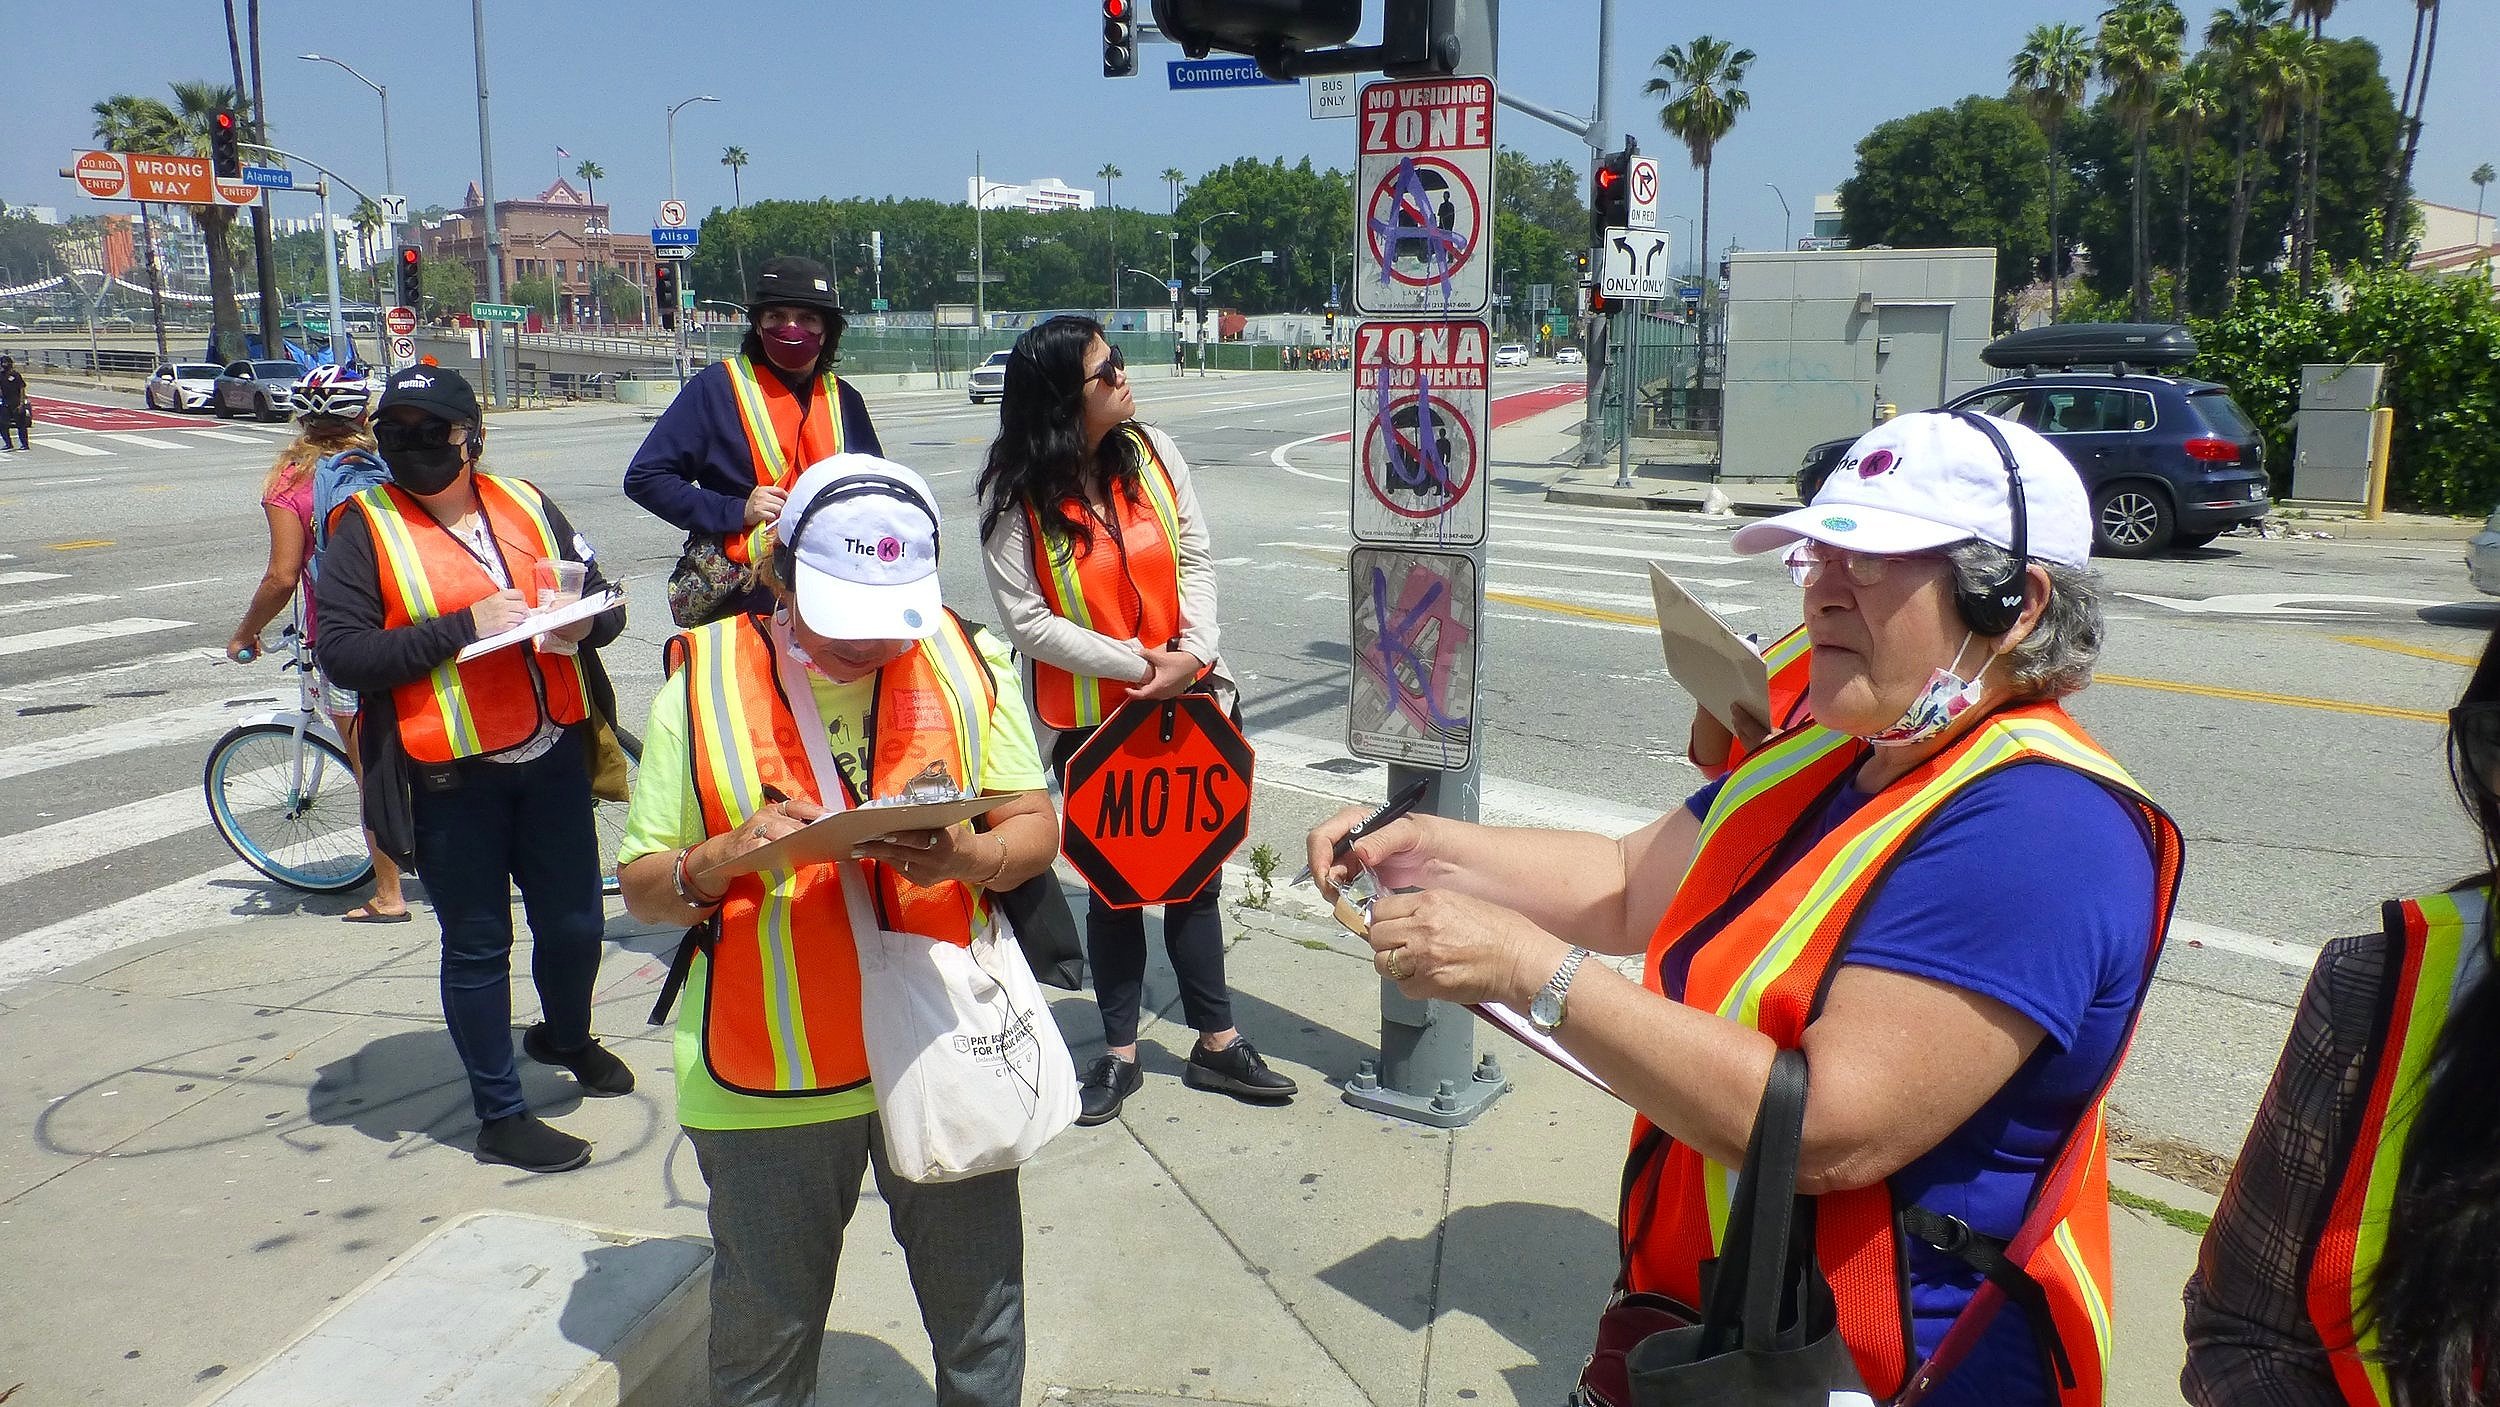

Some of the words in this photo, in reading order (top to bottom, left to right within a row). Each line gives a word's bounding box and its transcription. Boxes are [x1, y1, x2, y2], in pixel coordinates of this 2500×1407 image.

[1175, 64, 1264, 83] Commercia
[1321, 80, 1343, 91] BUS
[1319, 96, 1346, 107] ONLY
[1368, 90, 1394, 109] NO
[1399, 83, 1486, 107] VENDING
[1366, 106, 1486, 151] ZONE
[81, 159, 97, 169] DO
[97, 160, 118, 170] NOT
[135, 160, 203, 177] WRONG
[246, 171, 290, 184] Alameda
[85, 180, 118, 190] ENTER
[149, 181, 191, 195] WAY
[223, 187, 253, 197] ENTER
[1631, 209, 1641, 221] ON
[1642, 210, 1655, 222] RED
[659, 231, 689, 241] Aliso
[1606, 278, 1638, 292] ONLY
[1642, 279, 1664, 293] ONLY
[1360, 327, 1485, 365] ZONA
[1389, 368, 1416, 386] NO
[1420, 368, 1482, 386] VENTA
[397, 379, 426, 390] PUMA
[1835, 455, 1859, 474] he
[844, 538, 875, 556] The
[1095, 763, 1229, 840] SLOW
[1362, 801, 1391, 825] Metro
[970, 1036, 988, 1046] PAT
[972, 1045, 993, 1056] FOR
